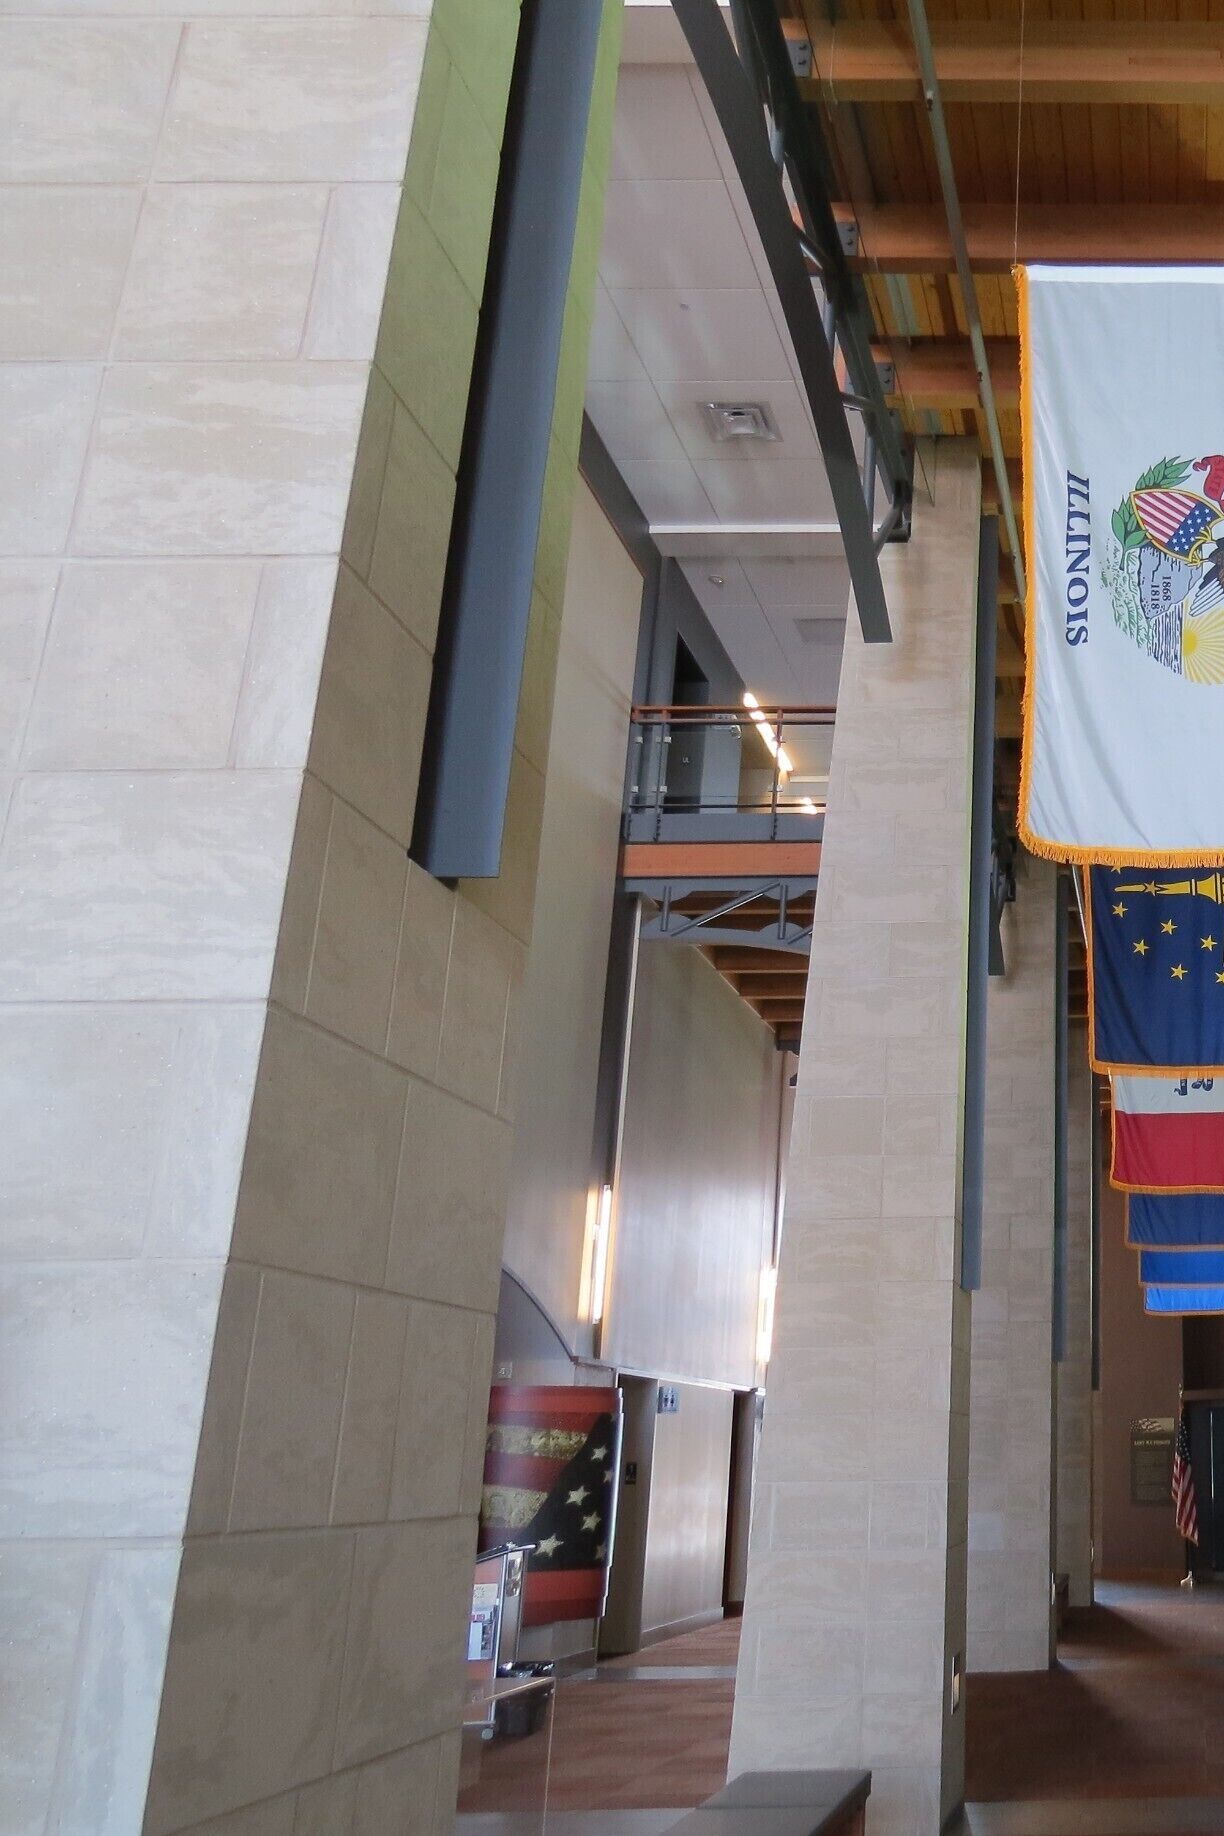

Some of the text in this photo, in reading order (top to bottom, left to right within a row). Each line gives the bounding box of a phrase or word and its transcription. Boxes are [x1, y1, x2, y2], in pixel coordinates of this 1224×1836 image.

[1066, 470, 1090, 647] ILLINOIS
[1150, 584, 1160, 610] 1818
[1162, 576, 1172, 601] 1868
